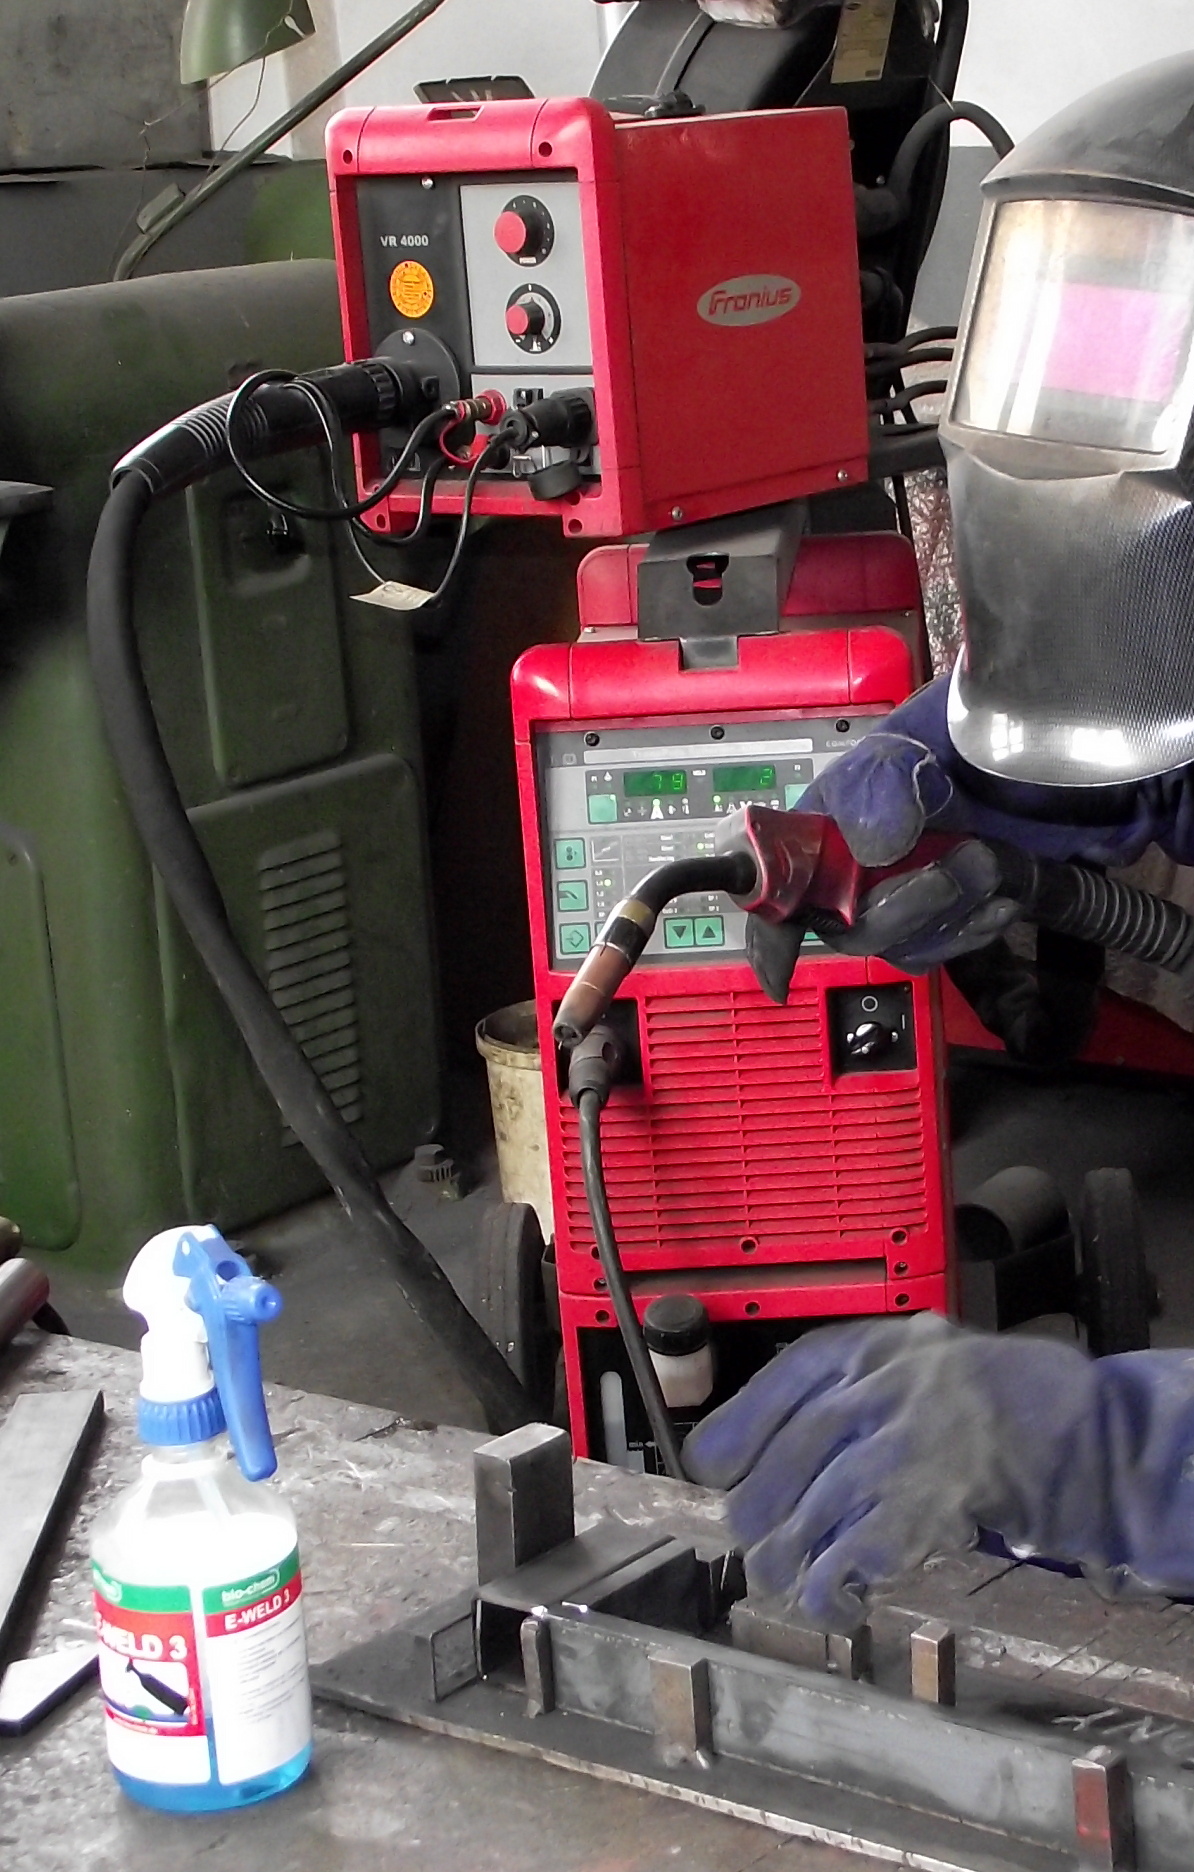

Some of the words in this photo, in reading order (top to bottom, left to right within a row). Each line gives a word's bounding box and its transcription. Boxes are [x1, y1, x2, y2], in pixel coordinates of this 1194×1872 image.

[380, 235, 398, 247] VR
[400, 234, 429, 247] 4000
[708, 285, 793, 316] Fronius
[224, 1594, 283, 1631] E-WELD
[168, 1634, 188, 1661] 3
